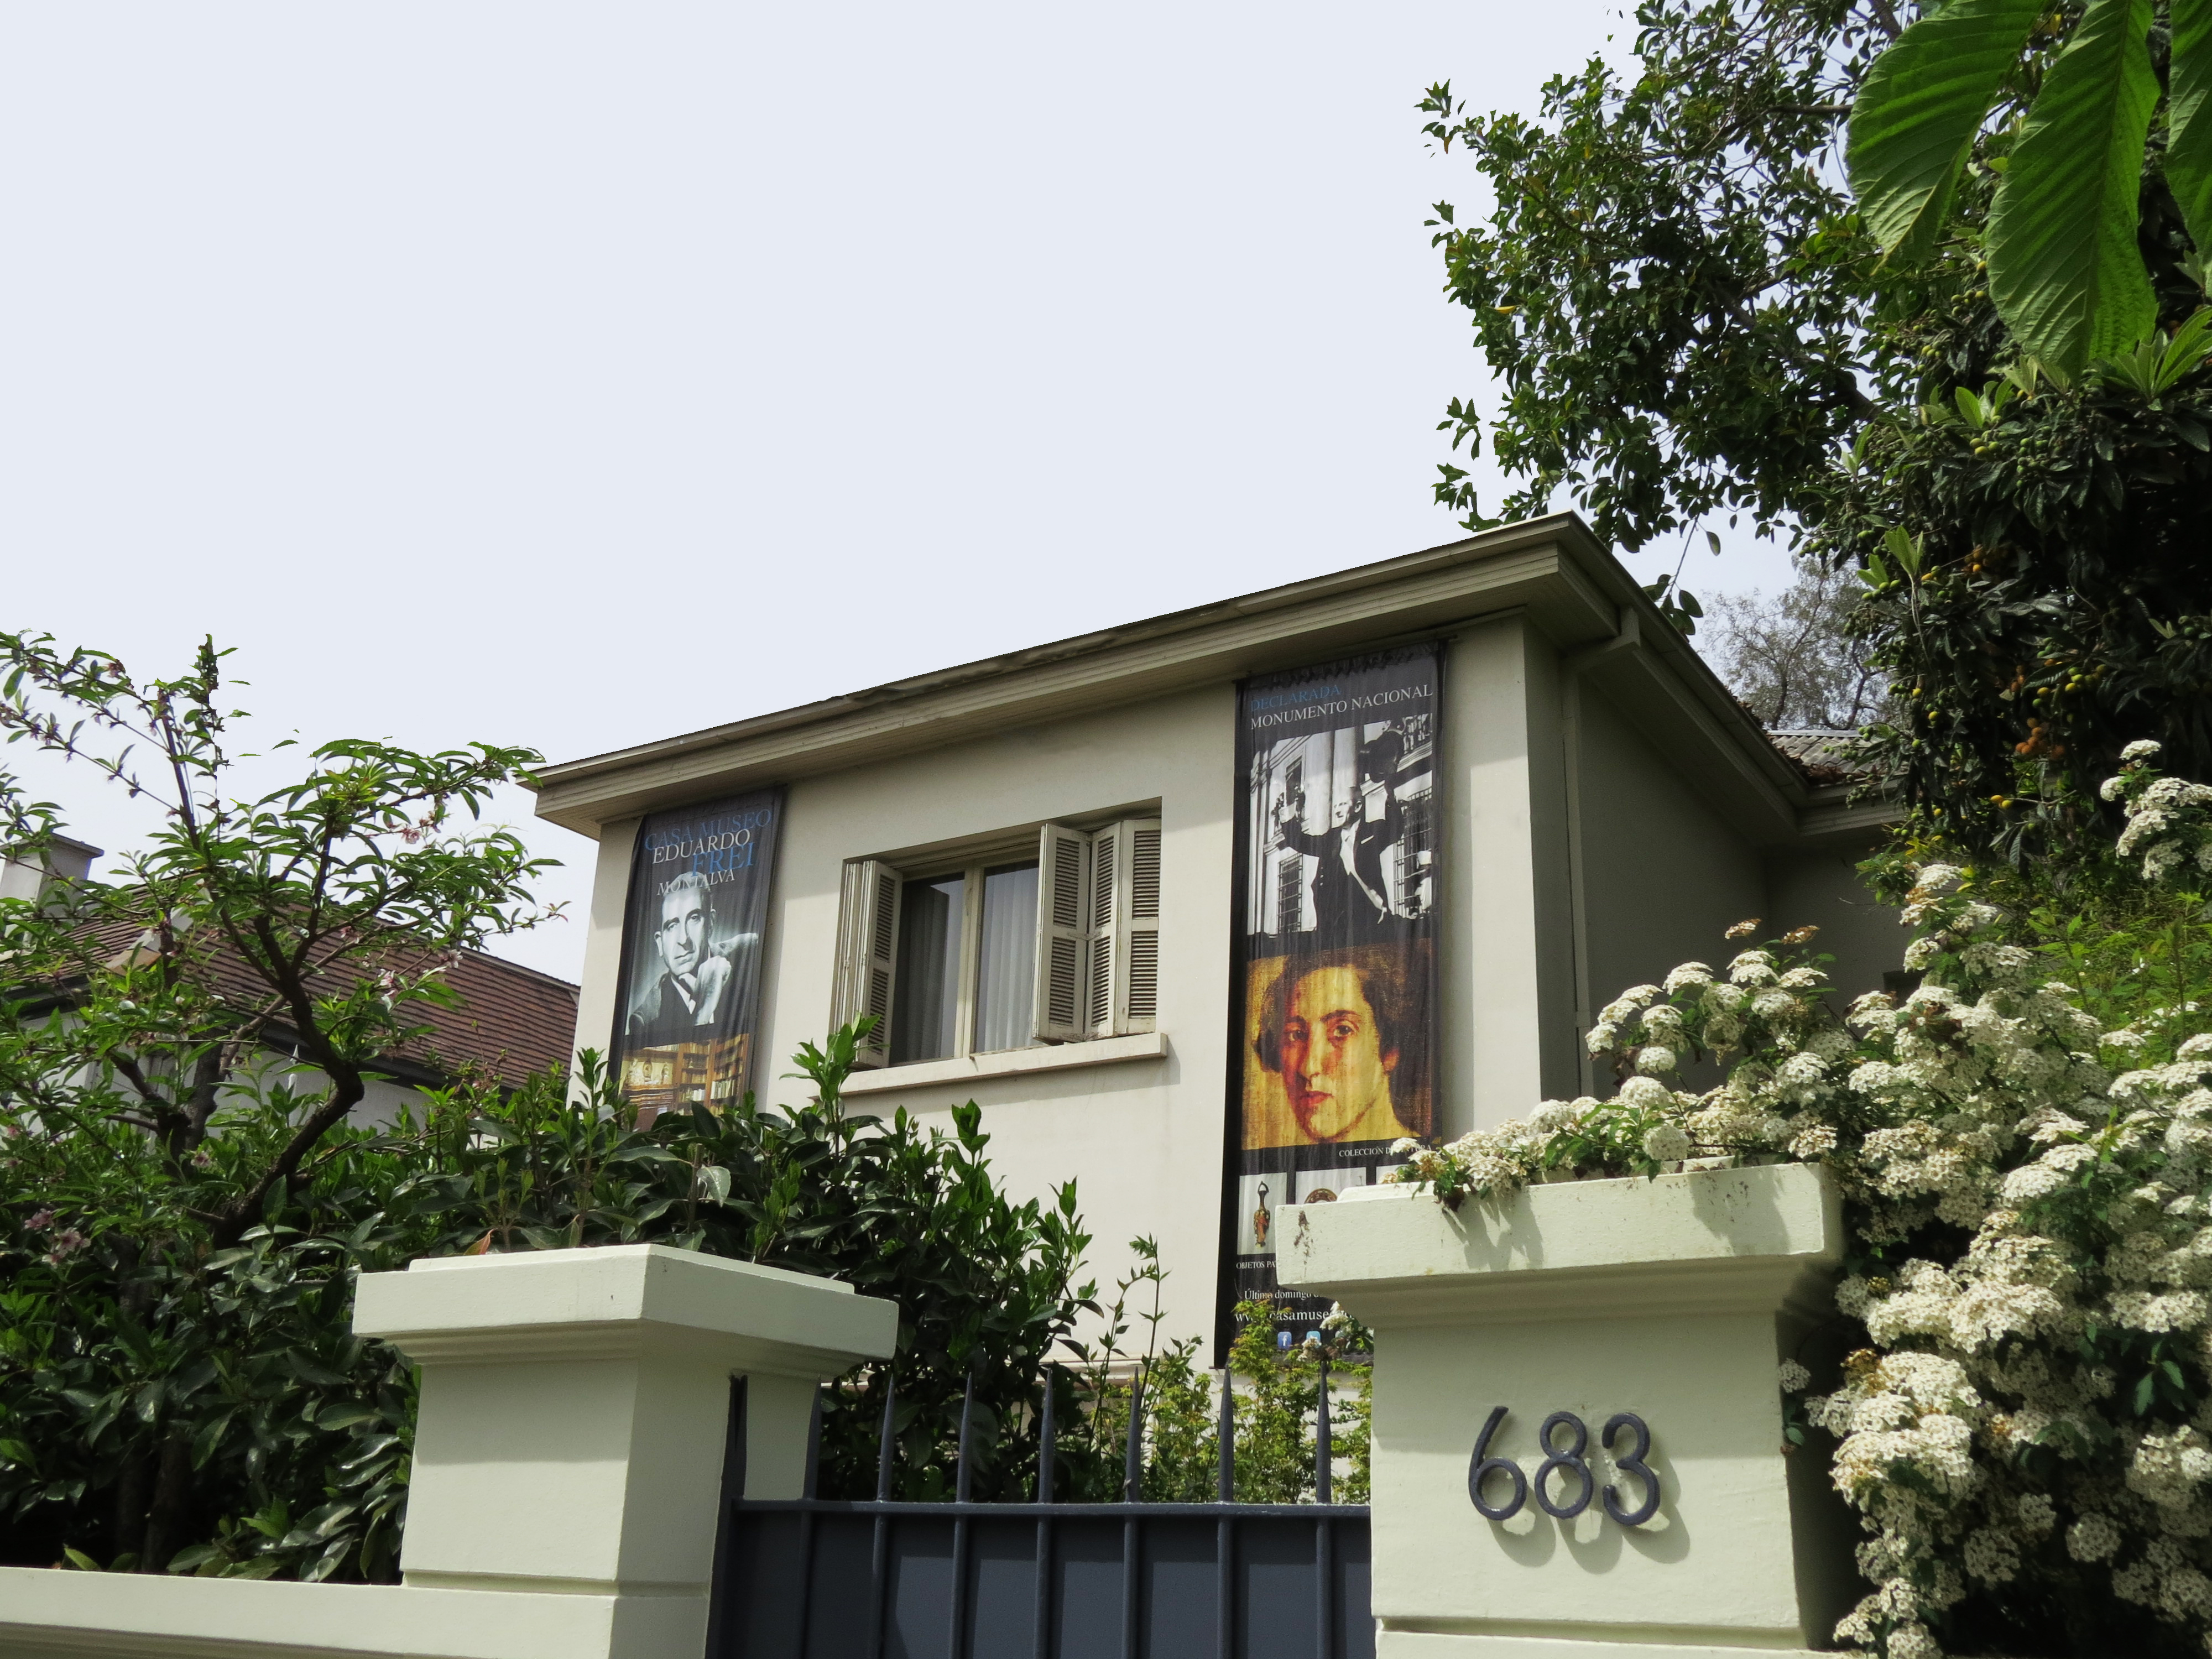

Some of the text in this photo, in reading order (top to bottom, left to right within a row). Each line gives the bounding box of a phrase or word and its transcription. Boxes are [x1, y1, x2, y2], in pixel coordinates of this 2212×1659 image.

[1250, 684, 1341, 712] DECLARADA
[1250, 684, 1433, 730] MONUMENTO NACIONAL
[645, 808, 772, 851] CASA MUSEO
[653, 828, 750, 864] EDUARDO
[691, 842, 755, 877] FREI
[656, 869, 735, 896] MONTALVA
[1236, 1261, 1265, 1269] OBJETOS
[1468, 1406, 1660, 1526] 683
